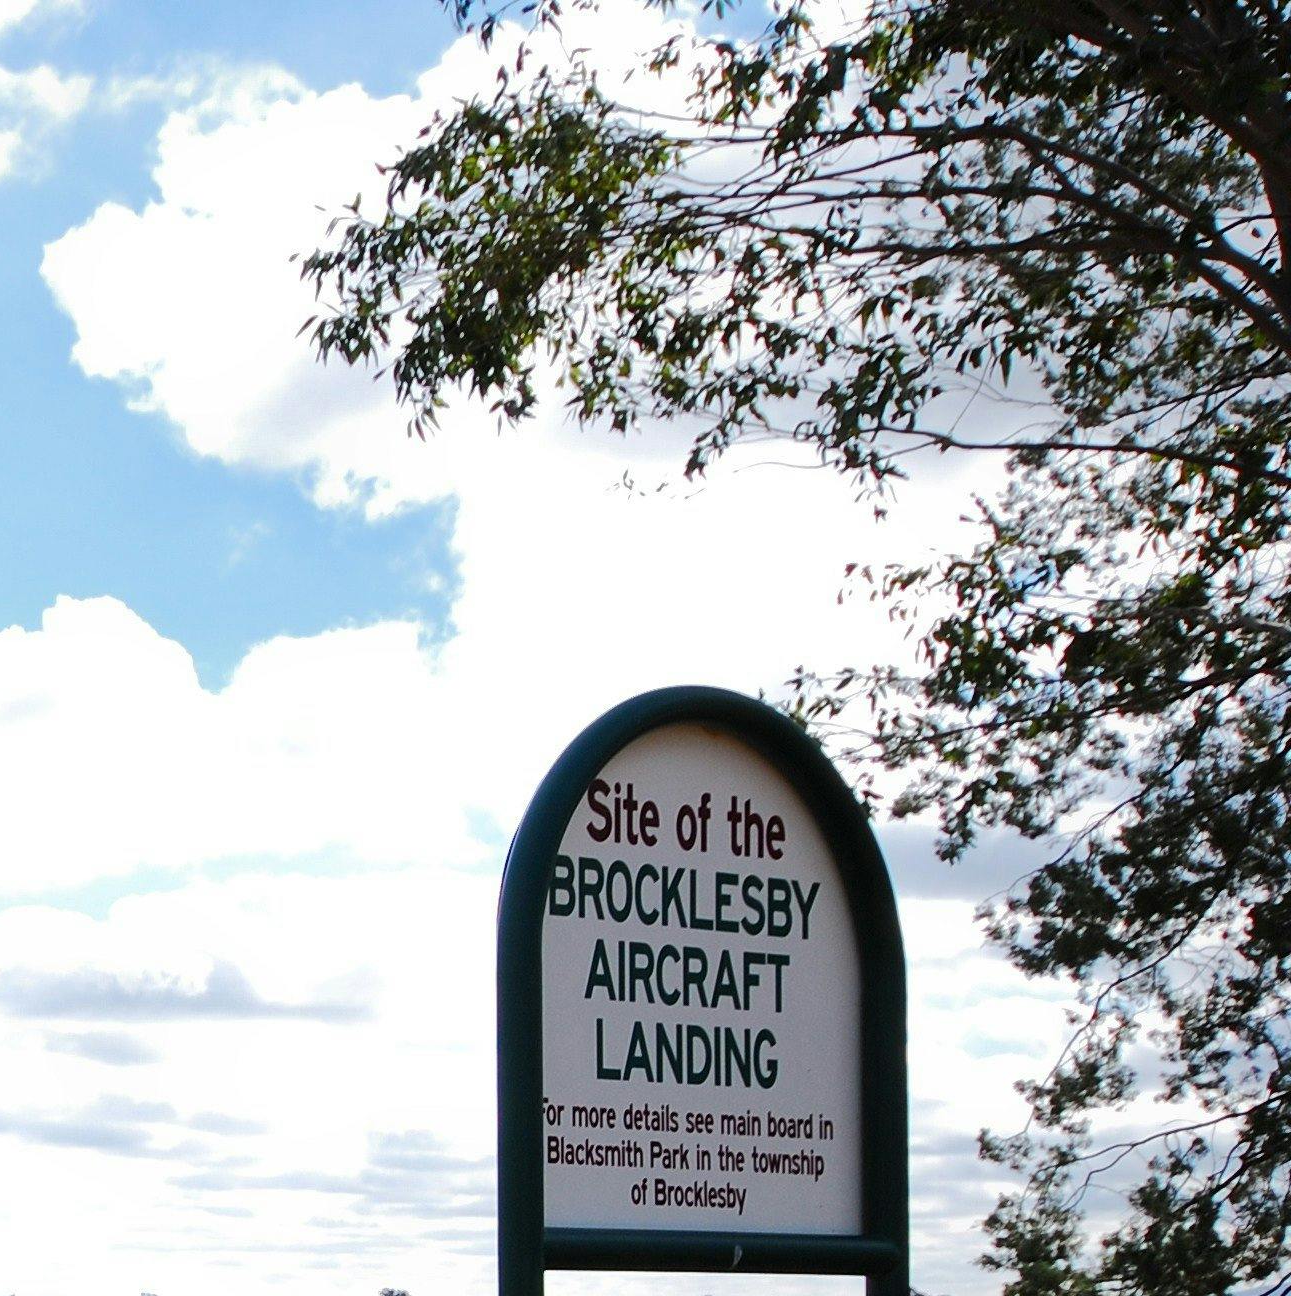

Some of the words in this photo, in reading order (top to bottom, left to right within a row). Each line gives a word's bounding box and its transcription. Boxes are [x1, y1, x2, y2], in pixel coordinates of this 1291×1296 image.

[587, 779, 660, 847] Site
[676, 793, 711, 852] of
[727, 796, 786, 860] the
[549, 854, 820, 939] BROCKLESBY
[584, 938, 790, 1013] AIRCRAFT
[596, 1018, 778, 1089] LANDING
[572, 1103, 616, 1130] more
[623, 1103, 679, 1133] details
[685, 1112, 714, 1134] see
[720, 1110, 761, 1137] main
[768, 1111, 813, 1139] board
[819, 1114, 833, 1140] in
[547, 1136, 644, 1168] Blacksmith
[650, 1141, 690, 1170] Park
[697, 1144, 711, 1171] in
[718, 1145, 745, 1173] the
[752, 1146, 825, 1182] township
[631, 1178, 648, 1205] of
[654, 1178, 747, 1215] Brocklesby
